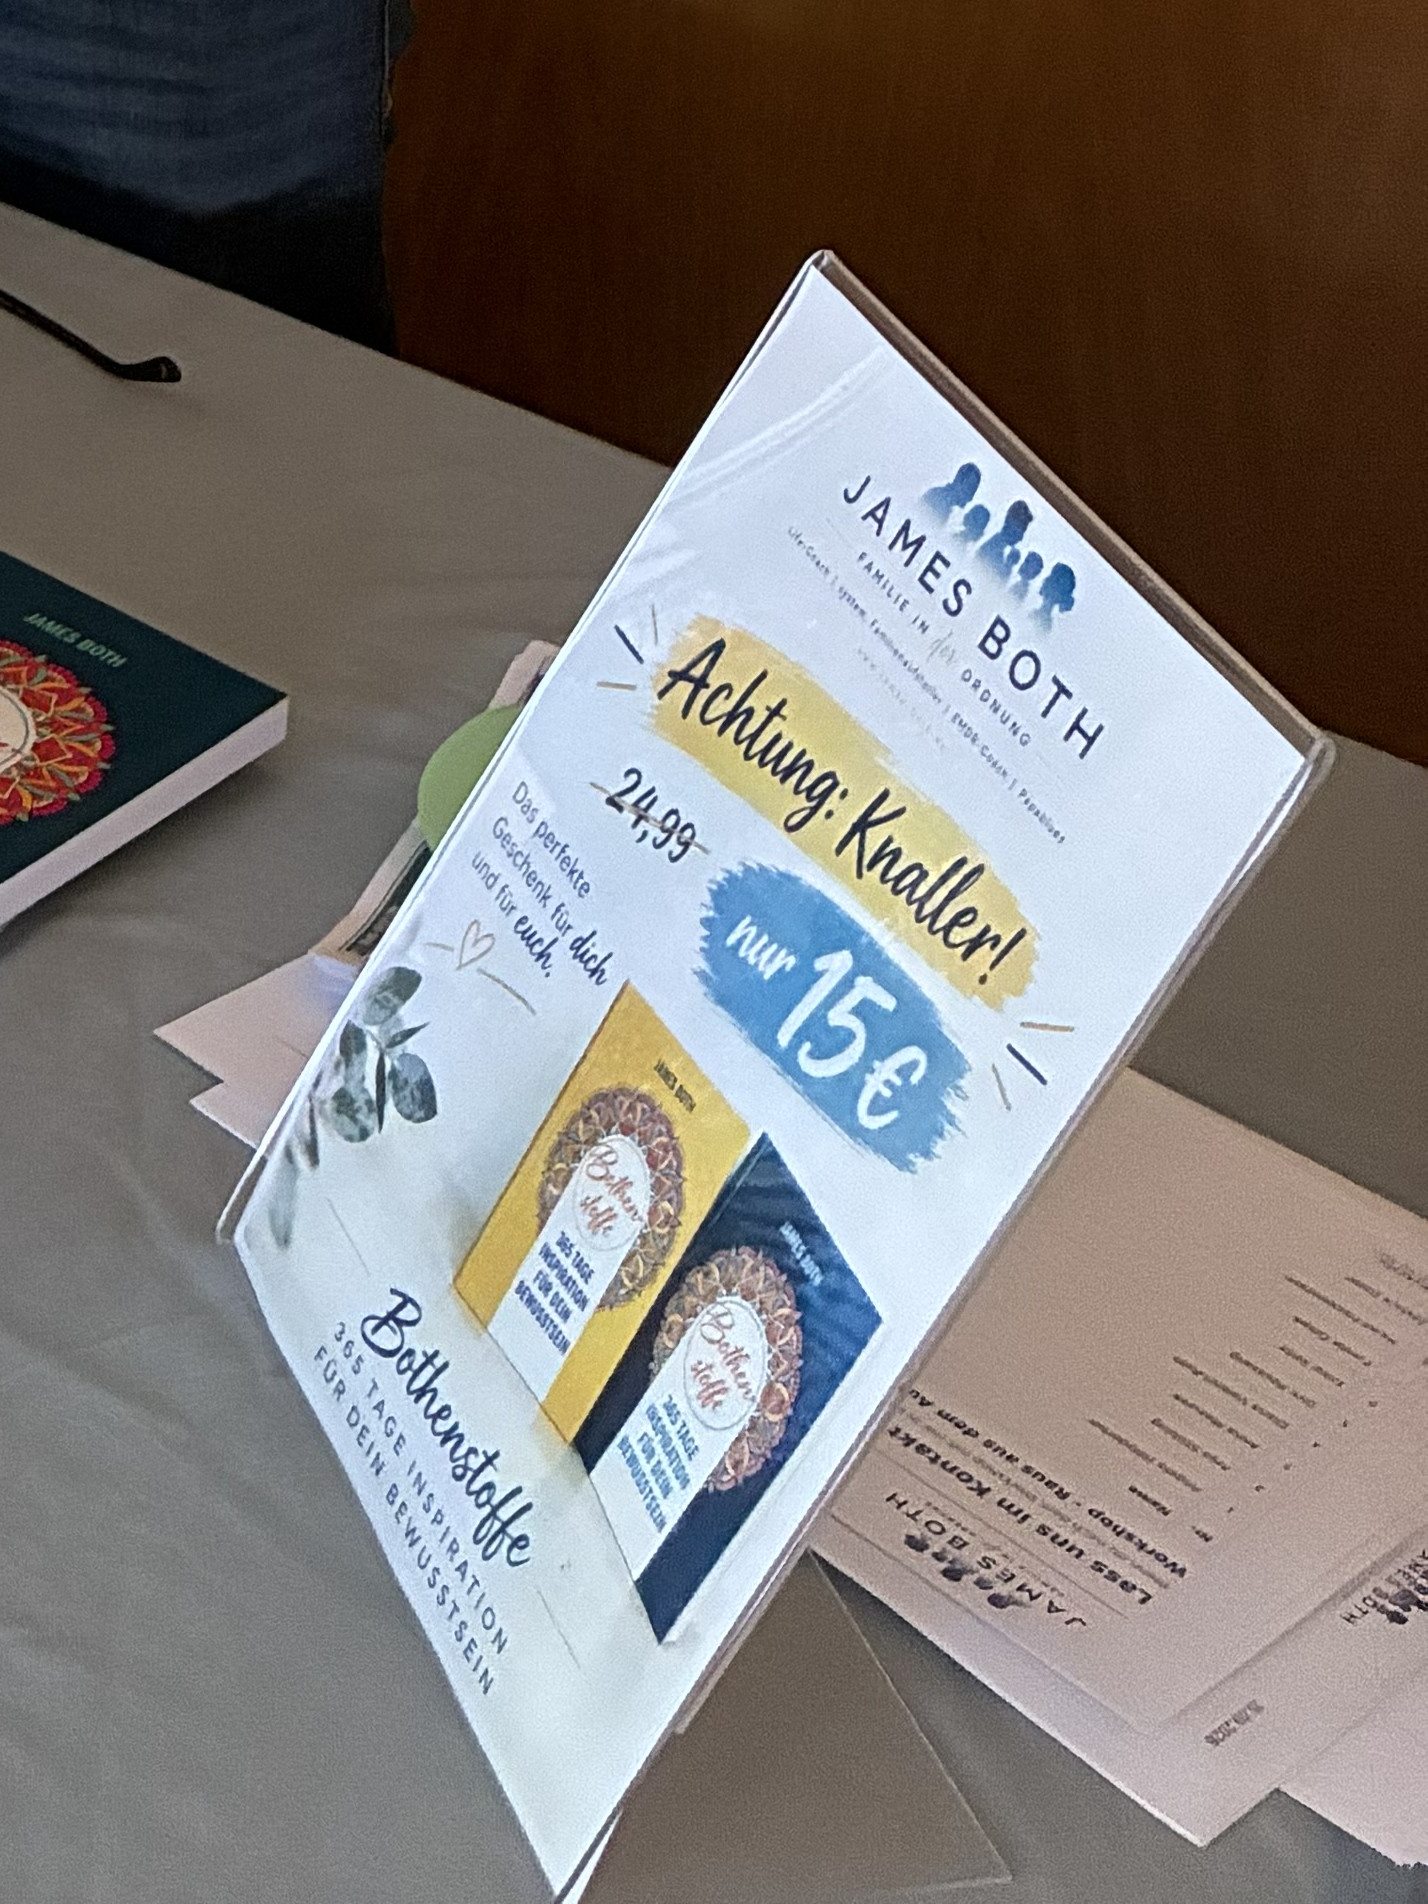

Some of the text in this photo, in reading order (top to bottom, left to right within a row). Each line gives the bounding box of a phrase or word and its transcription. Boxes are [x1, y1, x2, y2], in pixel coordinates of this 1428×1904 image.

[23, 613, 129, 668] JAMES BOTH
[843, 475, 973, 617] JAMES
[977, 614, 1105, 760] BOTH
[857, 552, 910, 612] FAMILIE
[912, 614, 930, 634] IN
[961, 668, 1031, 747] ORDNUNG
[512, 780, 591, 899] Das perfekte
[605, 767, 696, 863] 24,99
[656, 638, 849, 834] Achtung:
[835, 787, 1026, 986] Knaller!
[471, 851, 559, 978] und für euch.
[492, 817, 613, 986] Geschenk für dich
[725, 915, 797, 980] nur
[538, 1242, 590, 1313] INSPIRATION
[555, 1231, 595, 1285] 365 TAGE
[515, 1280, 571, 1355] BEWUSSTSEIN
[532, 1269, 573, 1324] FÜR DEIN
[360, 1287, 533, 1568] Bothenstoffe
[645, 1403, 691, 1490] INSPIRATION
[662, 1394, 700, 1461] 365 TAGE
[887, 1425, 992, 1498] Kontakt
[334, 1321, 508, 1655] 365 TAGE INSPIRATION
[617, 1435, 668, 1533] BEWUSSTSEIN
[637, 1431, 674, 1500] FÜR DEIN
[909, 1388, 1187, 1578] Workshop Raus aus dem Au
[314, 1345, 494, 1695] FÜR DEIN BEWUSSTSEIN
[885, 1493, 971, 1551] BOTH
[996, 1497, 1033, 1524] im
[1035, 1523, 1085, 1559] uns
[978, 1555, 1087, 1627] JAMES
[1090, 1560, 1153, 1605] Lass
